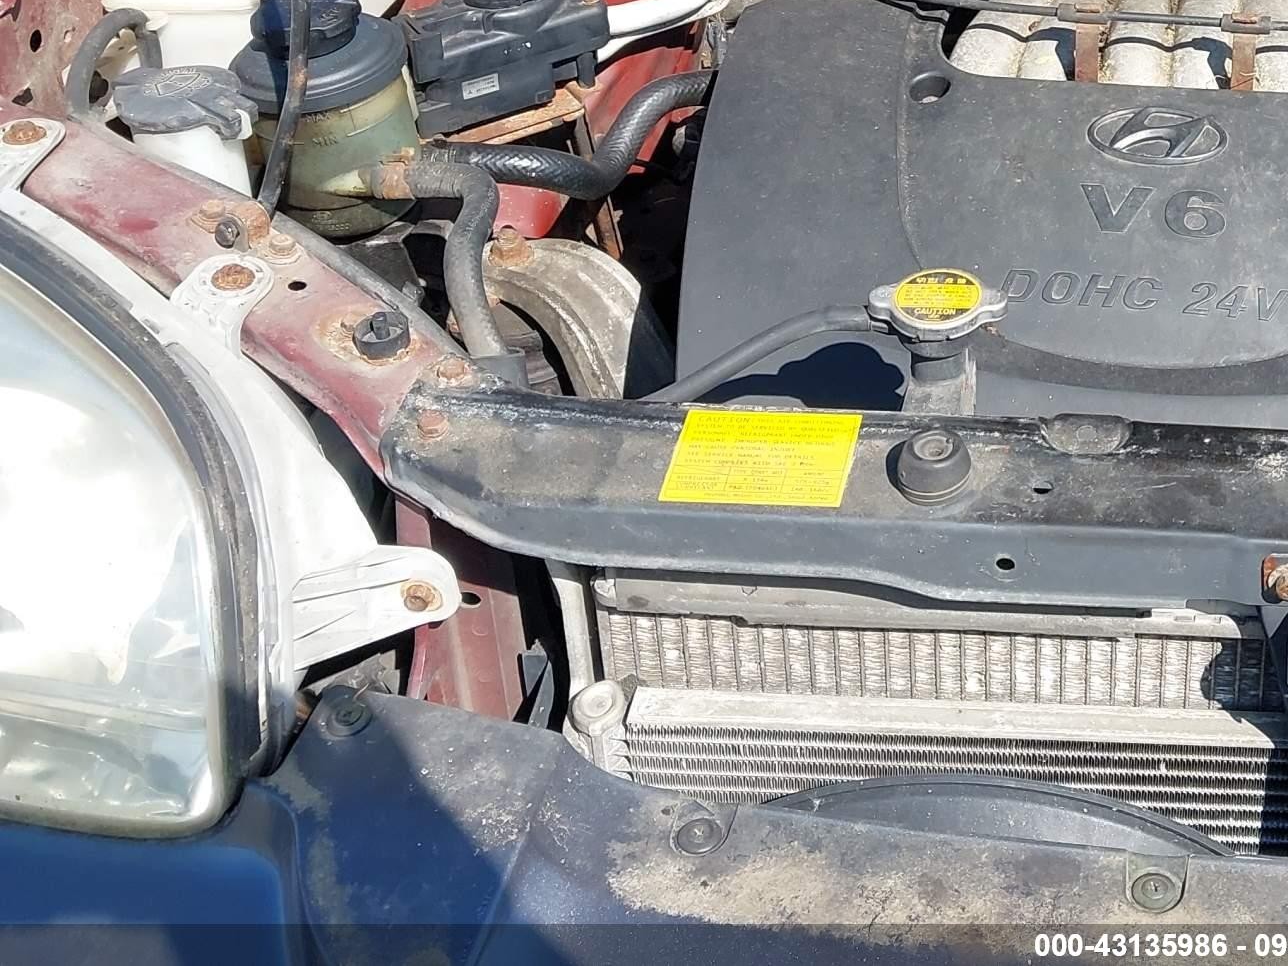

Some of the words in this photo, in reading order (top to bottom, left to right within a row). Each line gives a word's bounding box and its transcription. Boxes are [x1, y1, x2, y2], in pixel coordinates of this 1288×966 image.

[306, 112, 331, 123] MAX
[311, 135, 338, 147] MIN
[1000, 268, 1163, 311] DOHC
